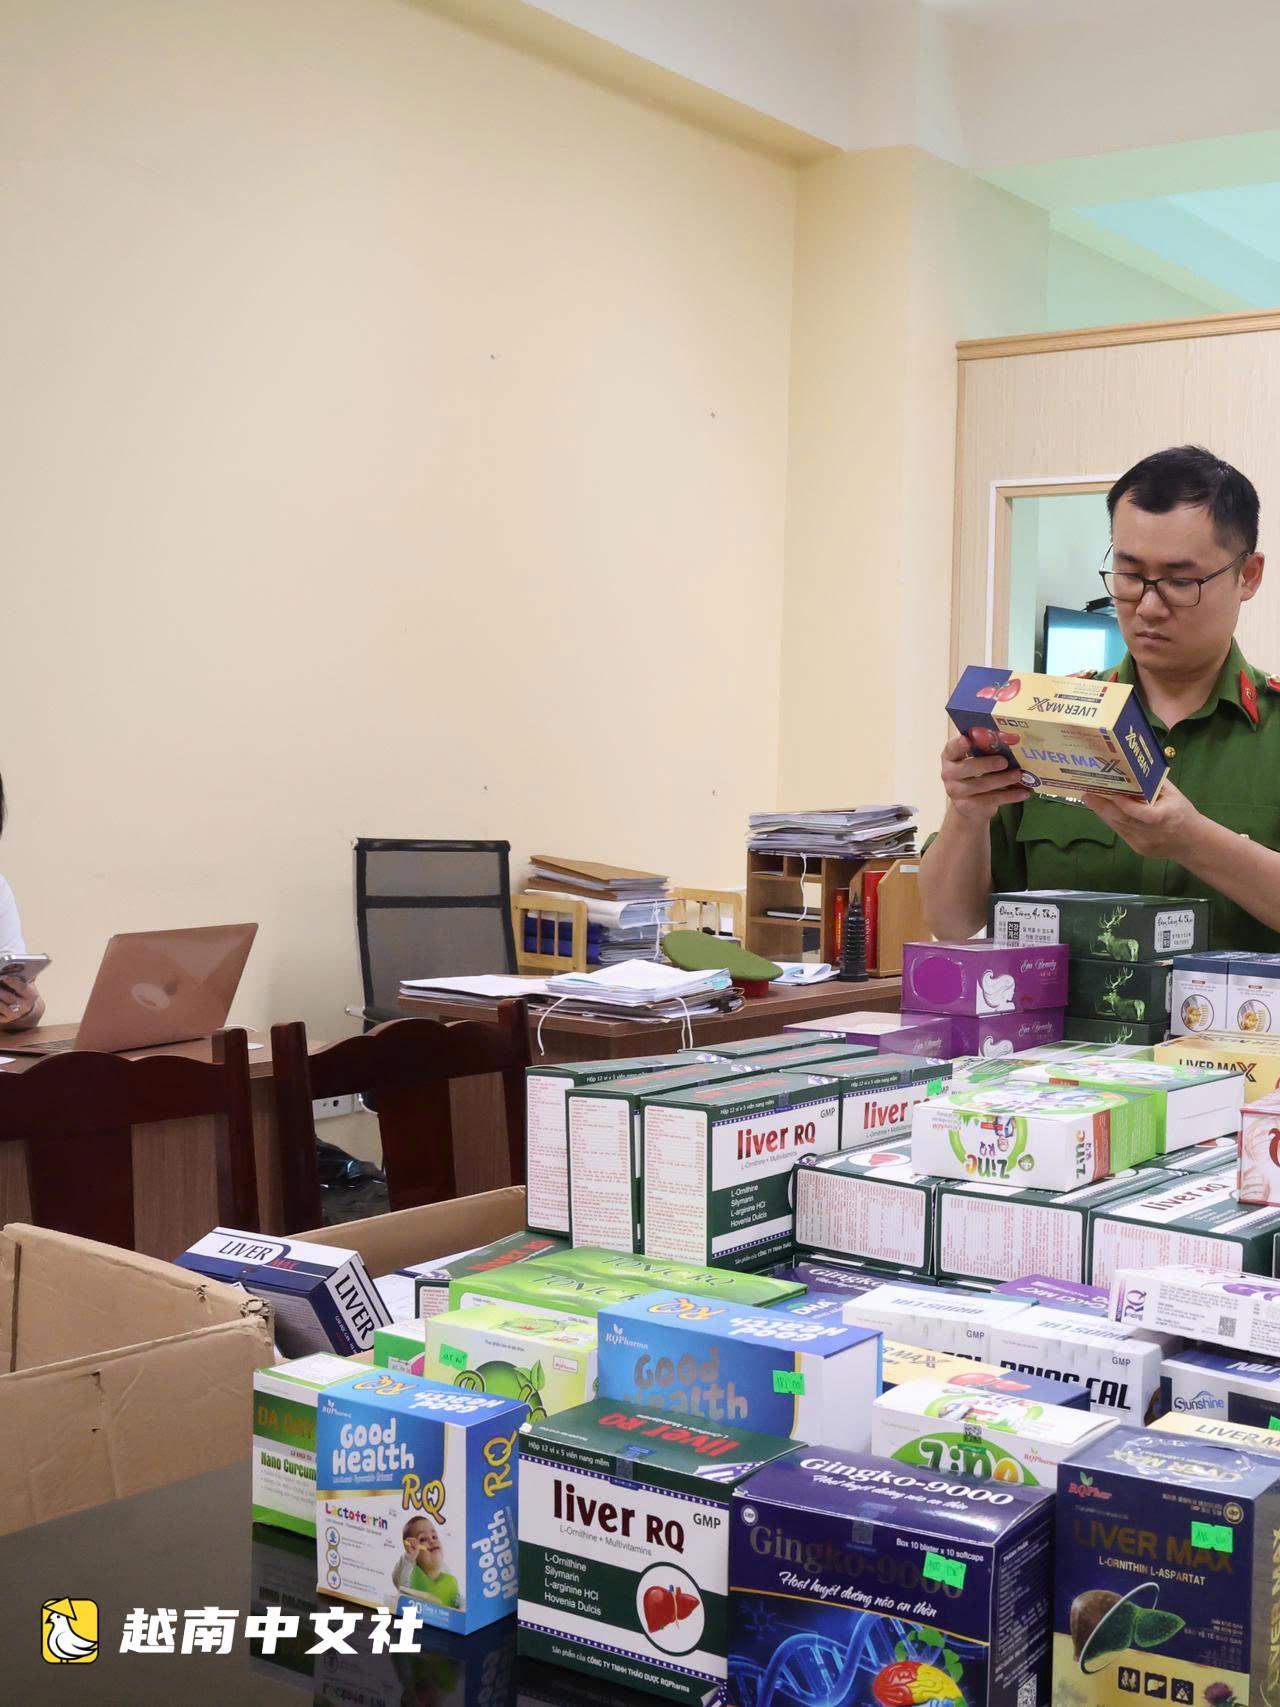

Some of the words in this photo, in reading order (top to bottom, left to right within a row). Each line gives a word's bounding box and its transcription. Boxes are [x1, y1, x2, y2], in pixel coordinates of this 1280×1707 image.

[1065, 704, 1097, 717] LIVER
[1021, 747, 1070, 764] LIVER
[1071, 753, 1127, 776] MAX
[820, 1107, 836, 1119] GMP
[863, 1100, 909, 1130] liver
[737, 1127, 789, 1160] liver
[794, 1121, 816, 1145] RQ
[979, 1141, 996, 1156] RQ
[730, 1184, 759, 1198] L-Ornithine
[1141, 1186, 1197, 1211] liver
[730, 1204, 756, 1217] L-arginine
[730, 1216, 751, 1228] Hovenia
[751, 1210, 768, 1223] Dulcis
[218, 1240, 273, 1261] LIVER
[335, 1274, 375, 1341] LIVER
[605, 1332, 649, 1350] RQPharma
[966, 1329, 985, 1340] GMP
[634, 1345, 720, 1390] Good
[1112, 1356, 1131, 1368] GMP
[1174, 1393, 1225, 1412] Sunshine
[340, 1417, 397, 1449] Good
[598, 1412, 647, 1433] RQ
[1195, 1424, 1260, 1442] LIVER
[640, 1423, 741, 1457] liver
[261, 1451, 281, 1470] Nano
[332, 1443, 415, 1475] Health
[483, 1430, 519, 1498] RQ
[528, 1440, 540, 1451] Hộp
[541, 1444, 549, 1452] 12
[560, 1449, 565, 1457] 5
[566, 1450, 578, 1460] viên
[579, 1454, 594, 1465] nang
[594, 1456, 610, 1467] mềm
[800, 1458, 1014, 1505] Gingko-9000
[402, 1473, 446, 1524] RQ
[325, 1503, 388, 1529] Lactoferrin
[554, 1479, 635, 1537] liver
[646, 1514, 685, 1554] RQ
[693, 1512, 721, 1530] GMP
[559, 1524, 598, 1543] L-Ornithine
[605, 1536, 652, 1557] Multivitamins
[896, 1538, 909, 1548] Box
[911, 1540, 919, 1550] 10
[920, 1542, 939, 1554] blister
[947, 1547, 954, 1557] 10
[956, 1549, 984, 1562] softcaps
[1072, 1519, 1157, 1560] LIVER
[488, 1509, 519, 1600] Health
[544, 1552, 587, 1572] L-Ornithine
[472, 1537, 501, 1599] Good
[544, 1565, 580, 1583] Silymarin
[1099, 1555, 1148, 1574] L-ORNITHIN
[1150, 1566, 1206, 1586] L-ASPARTAT
[544, 1578, 583, 1598] L-arginine
[584, 1587, 599, 1601] HCl
[810, 1578, 839, 1600] huyết
[841, 1586, 873, 1607] dưỡng
[875, 1596, 894, 1609] não
[897, 1601, 911, 1613] an
[913, 1600, 939, 1618] thần
[544, 1592, 577, 1610] Hovenia
[577, 1599, 602, 1616] Dulcis
[587, 1655, 602, 1667] CÔNG
[602, 1660, 611, 1669] TY
[660, 1677, 690, 1693] RQPharma
